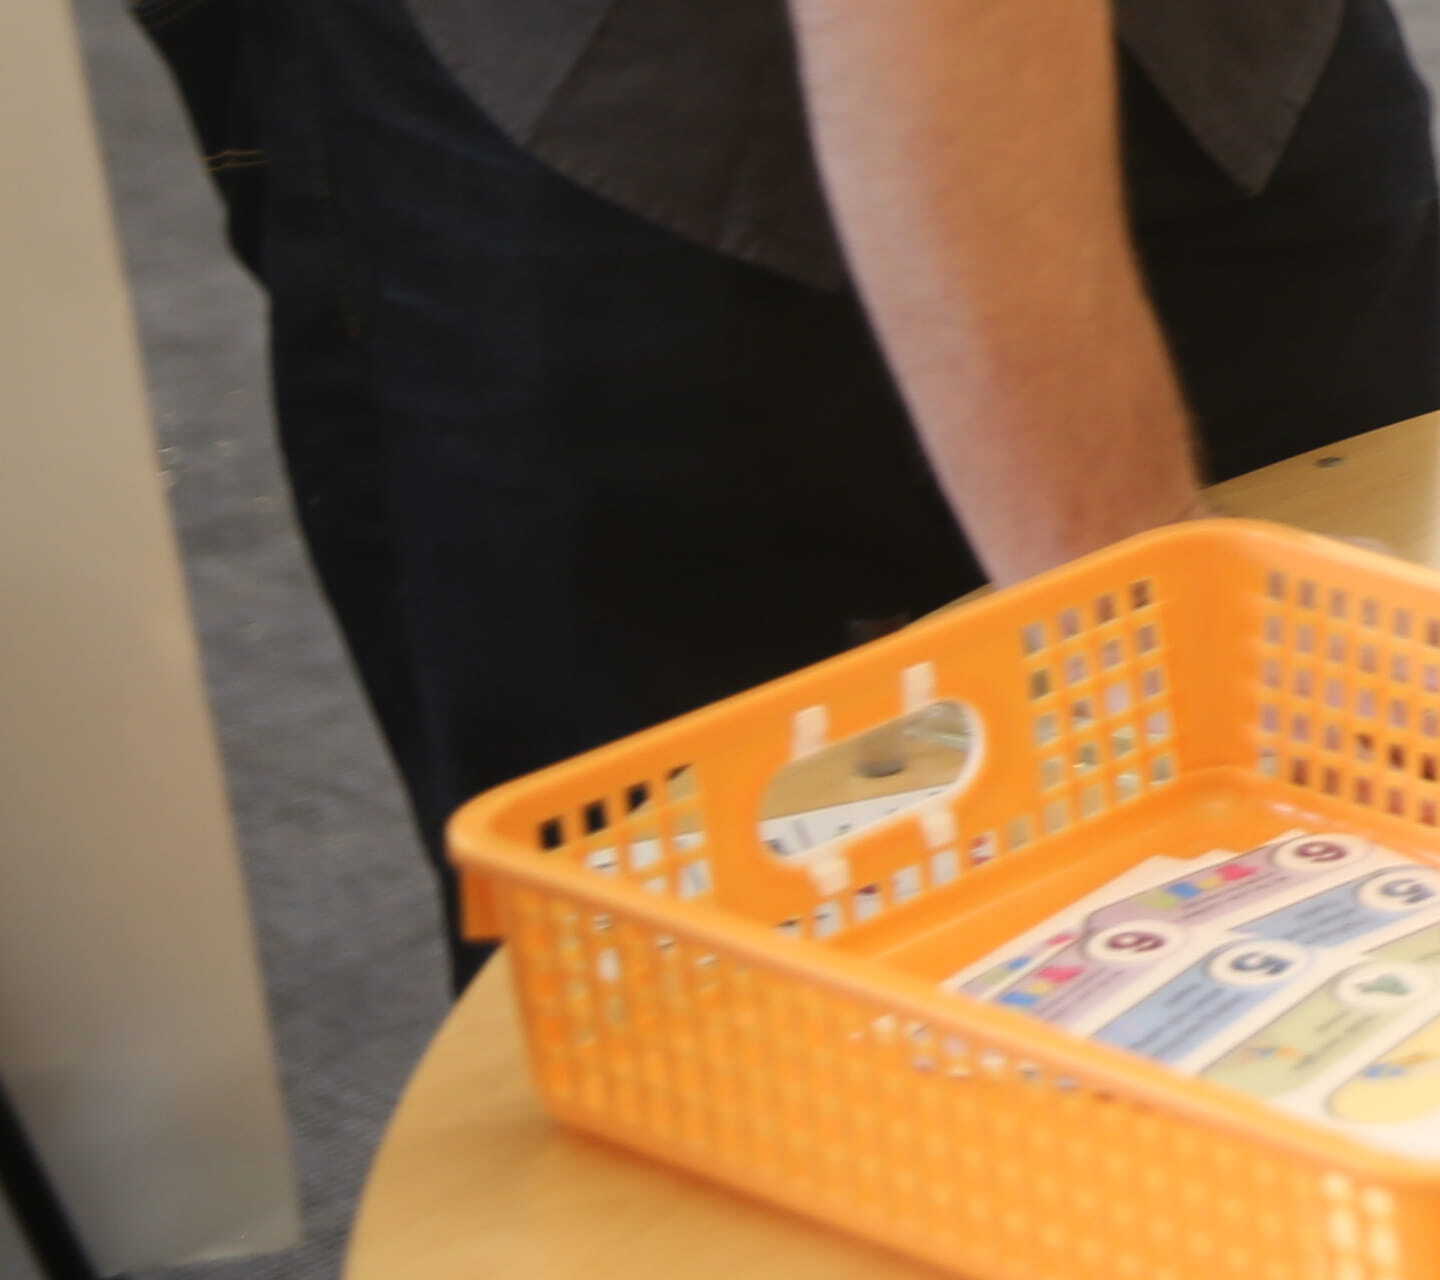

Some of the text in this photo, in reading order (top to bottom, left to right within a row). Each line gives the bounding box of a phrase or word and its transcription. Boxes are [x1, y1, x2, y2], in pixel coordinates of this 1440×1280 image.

[1294, 840, 1349, 864] 6
[1379, 877, 1435, 905] 5
[1105, 930, 1167, 954] 6
[1229, 951, 1293, 977] 5
